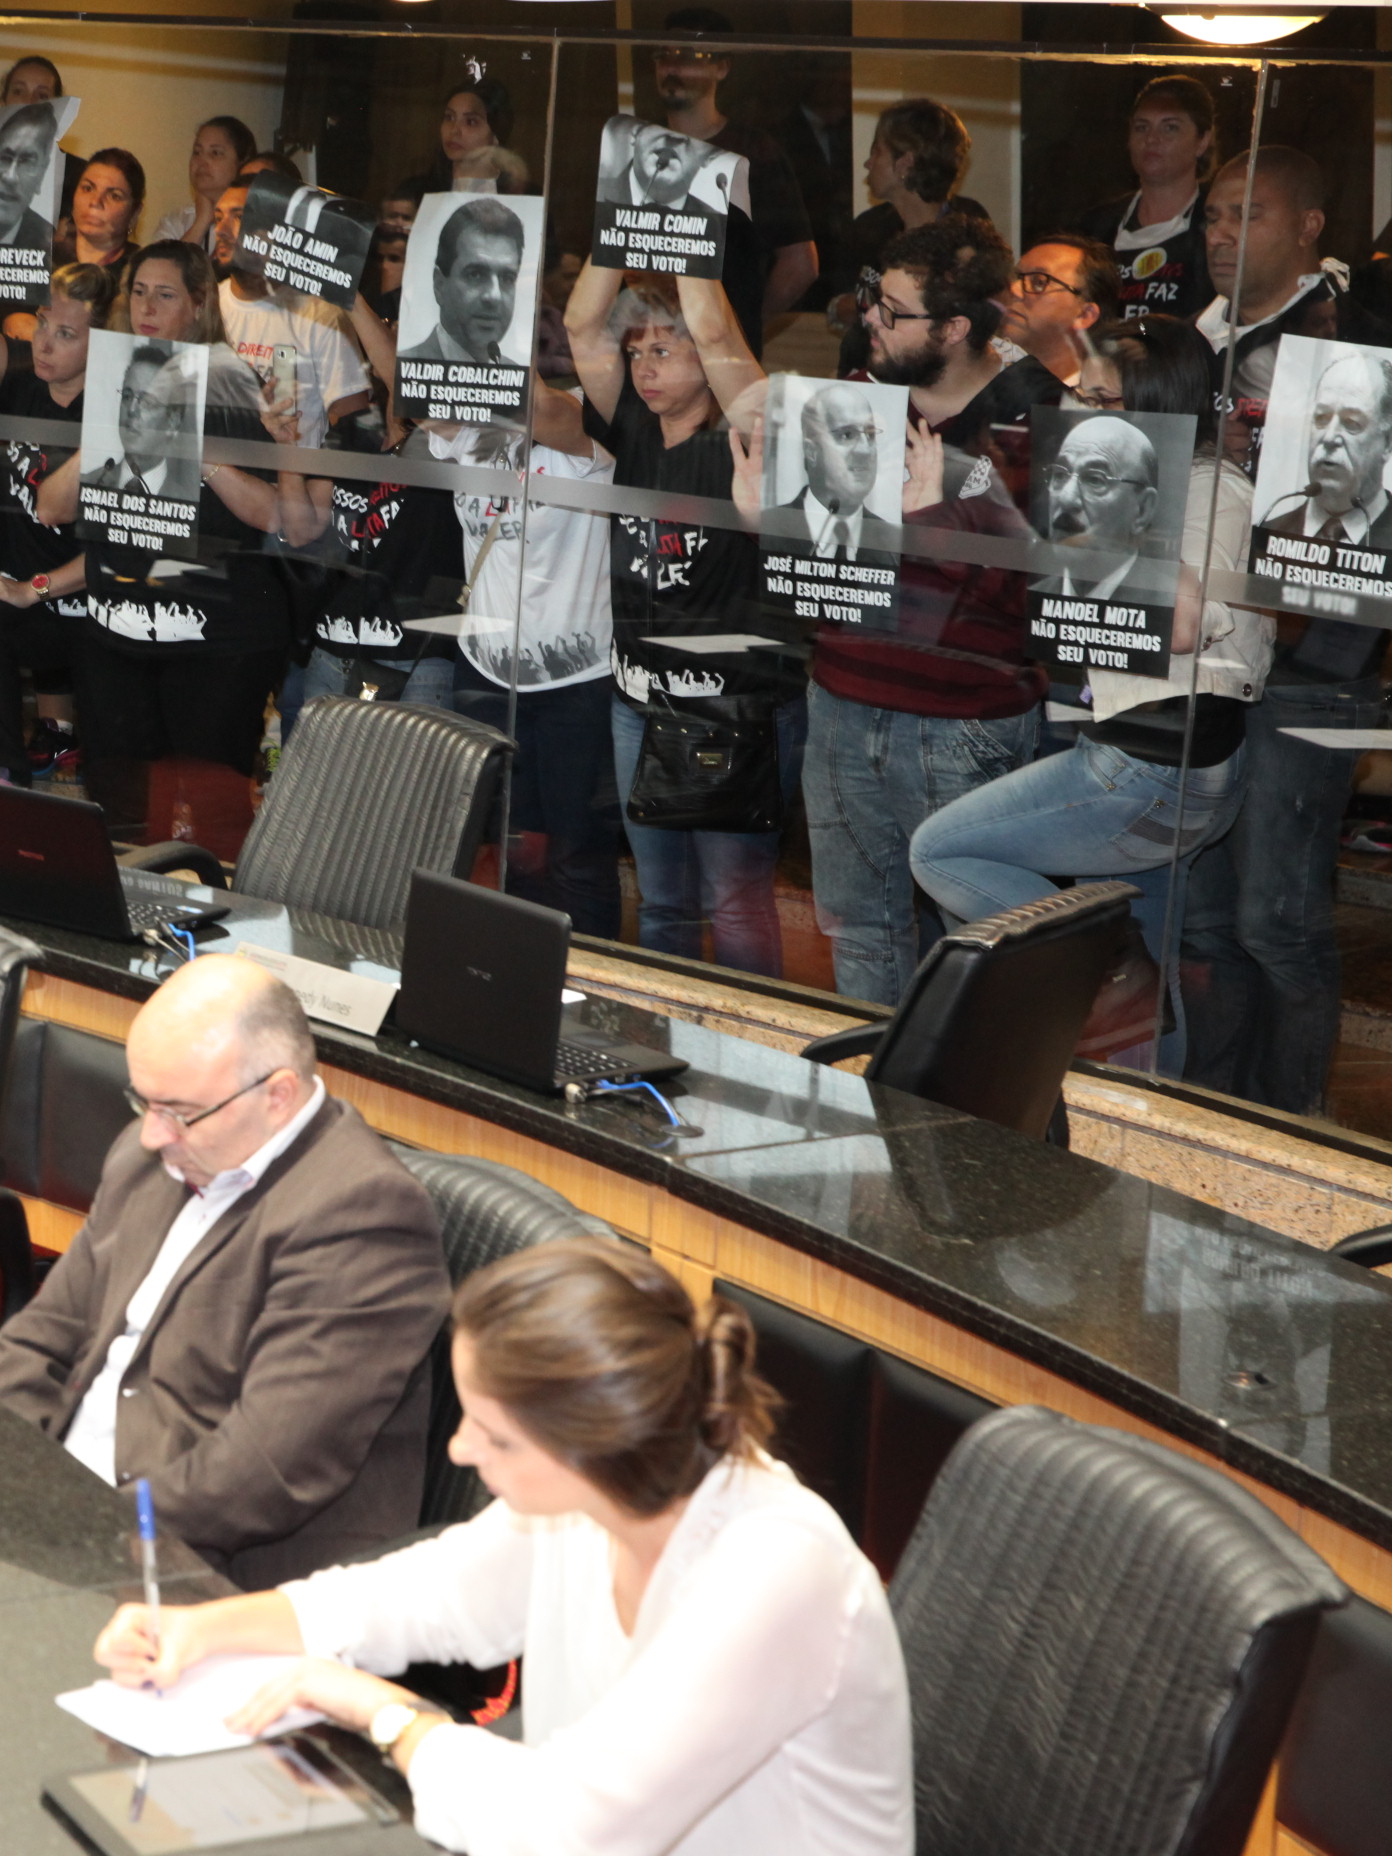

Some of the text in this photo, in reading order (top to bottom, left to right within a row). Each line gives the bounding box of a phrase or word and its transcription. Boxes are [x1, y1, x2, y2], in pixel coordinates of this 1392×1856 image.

[616, 209, 708, 235] VALMIR COMIN
[267, 224, 339, 263] JOÃO AMIN
[600, 227, 716, 257] NÃO ESQUECEREMOS
[243, 234, 352, 288] NÃO ESQUECEREMOS
[625, 252, 687, 273] SEU VOTO!
[264, 262, 322, 296] SEU VOTO!
[1145, 282, 1179, 302] FAZ
[400, 362, 525, 387] VALDIR COBALCHINI
[401, 381, 520, 406] NÃO ESQUECEREMOS
[428, 403, 491, 422] SEU VOTO!
[80, 487, 196, 521] ISMAEL DOS SANTOS
[84, 506, 190, 538] NÃO ESQUECEREMOS
[108, 528, 163, 551] SEU VOTO!
[1267, 535, 1386, 575] ROMILDO TITON
[764, 555, 895, 586] JOSÉ MILTON SCHEFFER
[1255, 557, 1392, 597] NÃO ESQUECEREMOS
[767, 576, 892, 607] NÃO ESQUECEREMOS
[795, 600, 862, 623] SEU VOTO!
[1041, 598, 1146, 629] MANOEL MOTA
[1031, 618, 1161, 652] NÃO ESQUECEREMOS
[1057, 645, 1128, 669] SEU VOTO!
